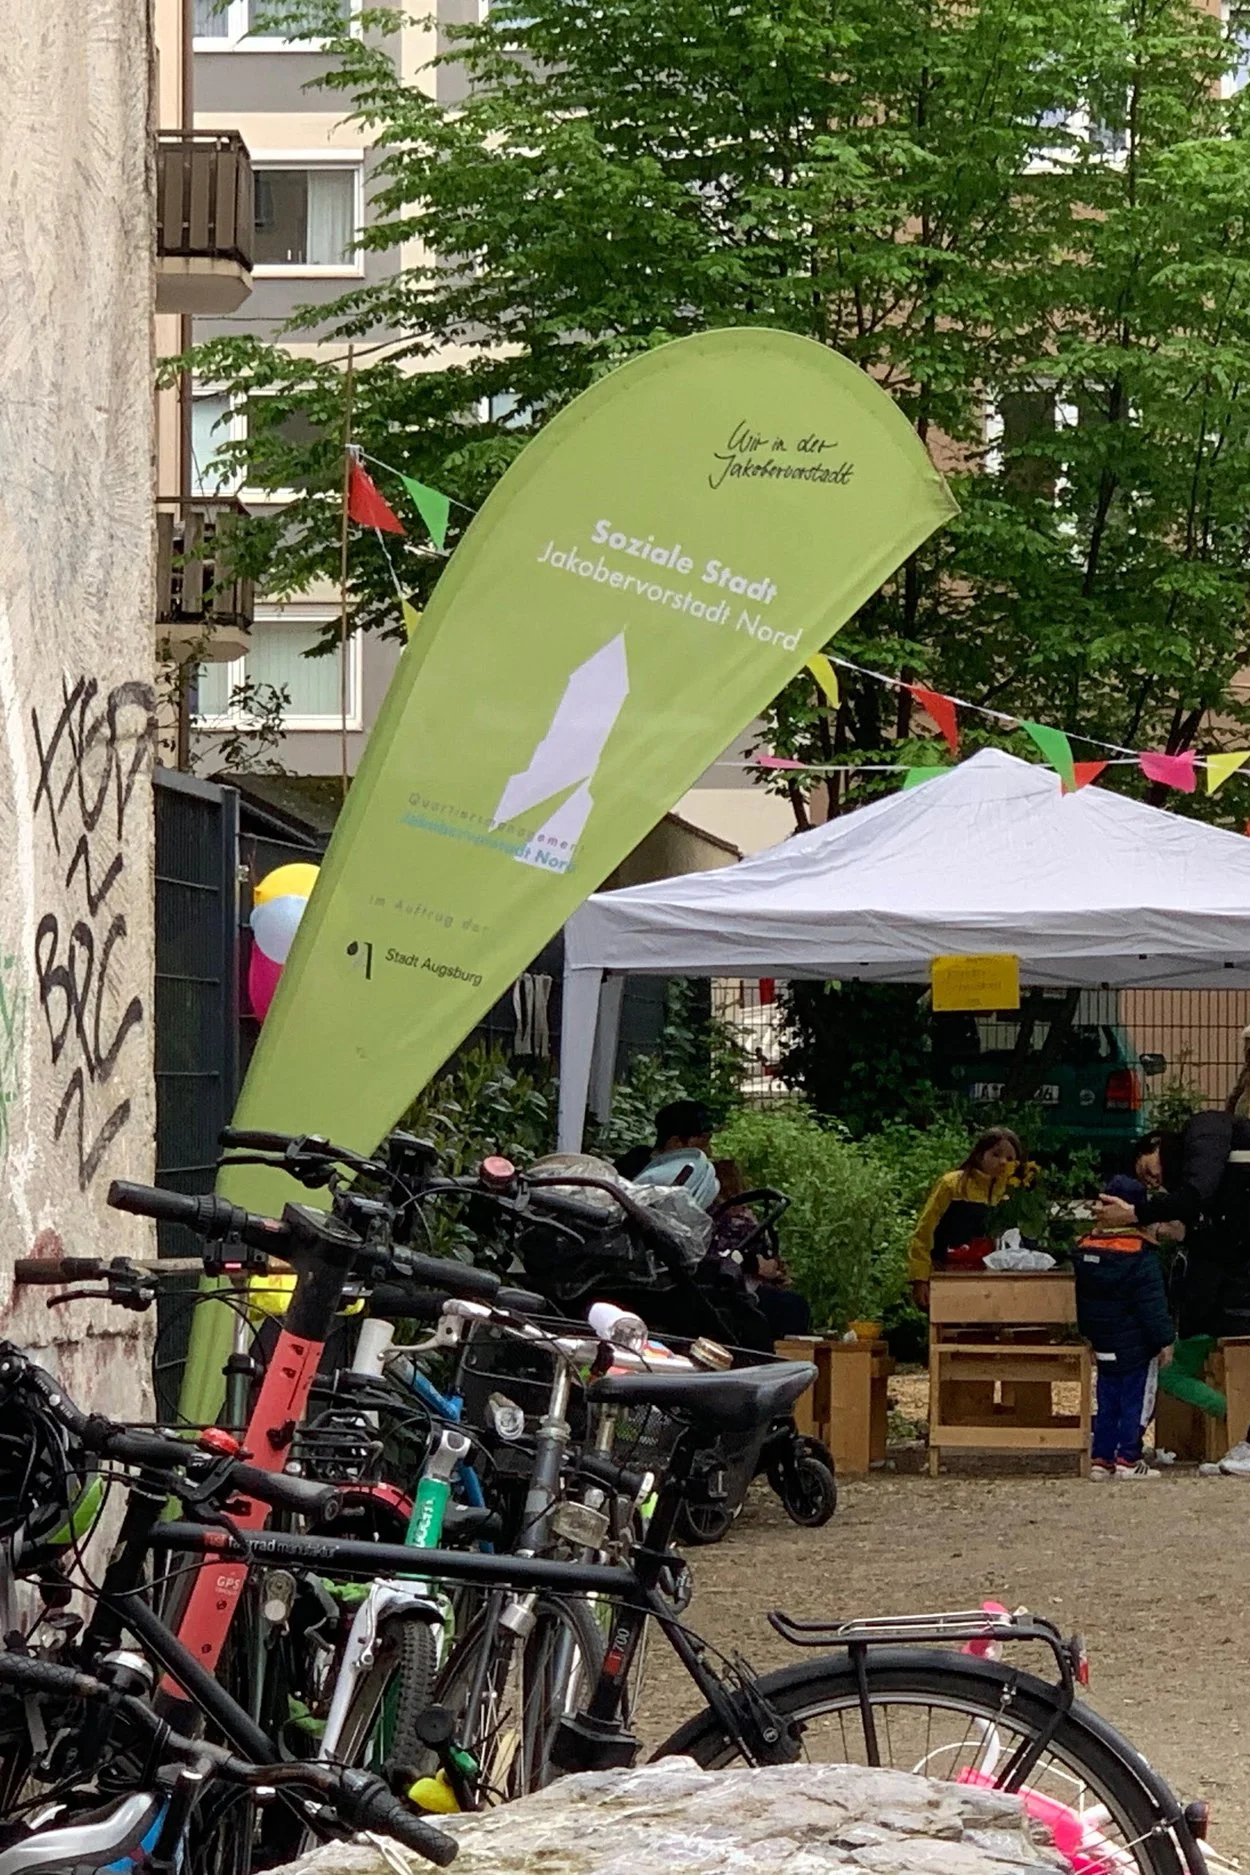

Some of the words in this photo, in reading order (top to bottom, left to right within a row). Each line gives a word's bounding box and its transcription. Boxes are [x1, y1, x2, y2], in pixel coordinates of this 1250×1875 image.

[728, 420, 768, 453] Wir
[772, 437, 786, 451] in
[797, 434, 838, 453] der
[709, 452, 853, 490] Jakobervorstadt
[592, 519, 694, 574] Soziale
[701, 559, 778, 604] Stadt
[537, 541, 731, 624] Jakobervorstadt
[735, 609, 804, 651] Nord
[385, 948, 419, 968] Stadt
[421, 957, 483, 987] Augsburg
[216, 1576, 240, 1590] GPS
[612, 1628, 630, 1653] 700
